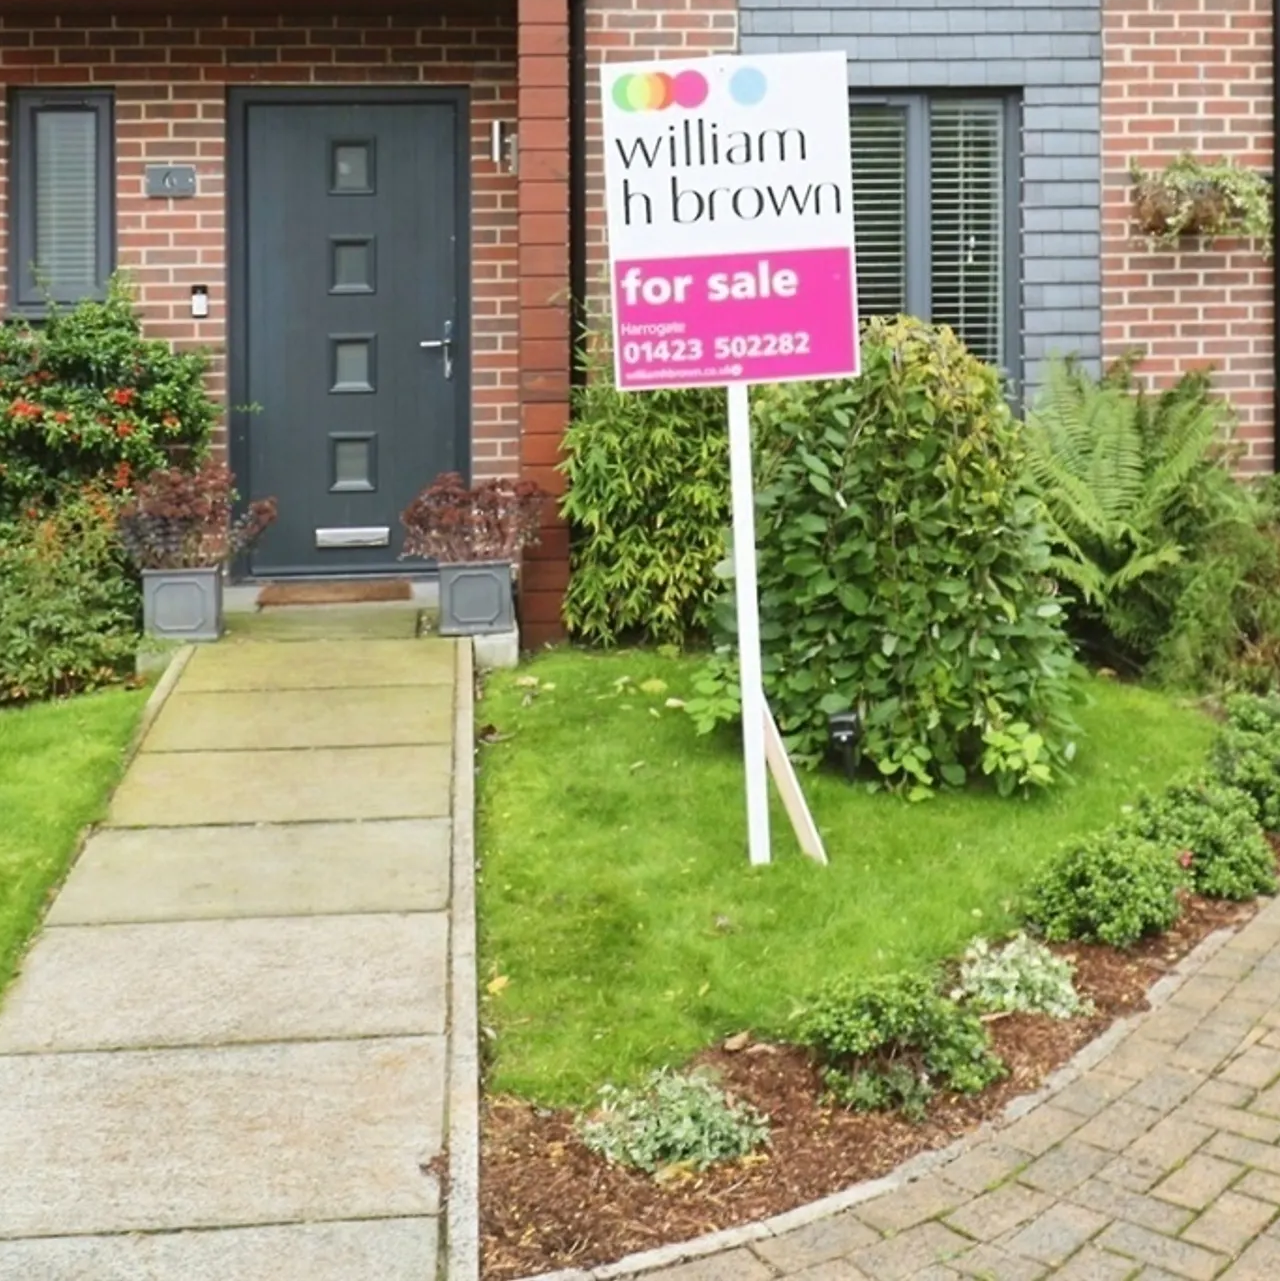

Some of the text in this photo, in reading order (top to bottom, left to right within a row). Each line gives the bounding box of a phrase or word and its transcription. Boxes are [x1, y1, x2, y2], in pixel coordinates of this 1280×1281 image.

[615, 118, 808, 169] william
[623, 175, 842, 225] h brown
[621, 260, 799, 306] for sale
[620, 321, 686, 337] Harrogate
[623, 332, 810, 364] 01423 502282
